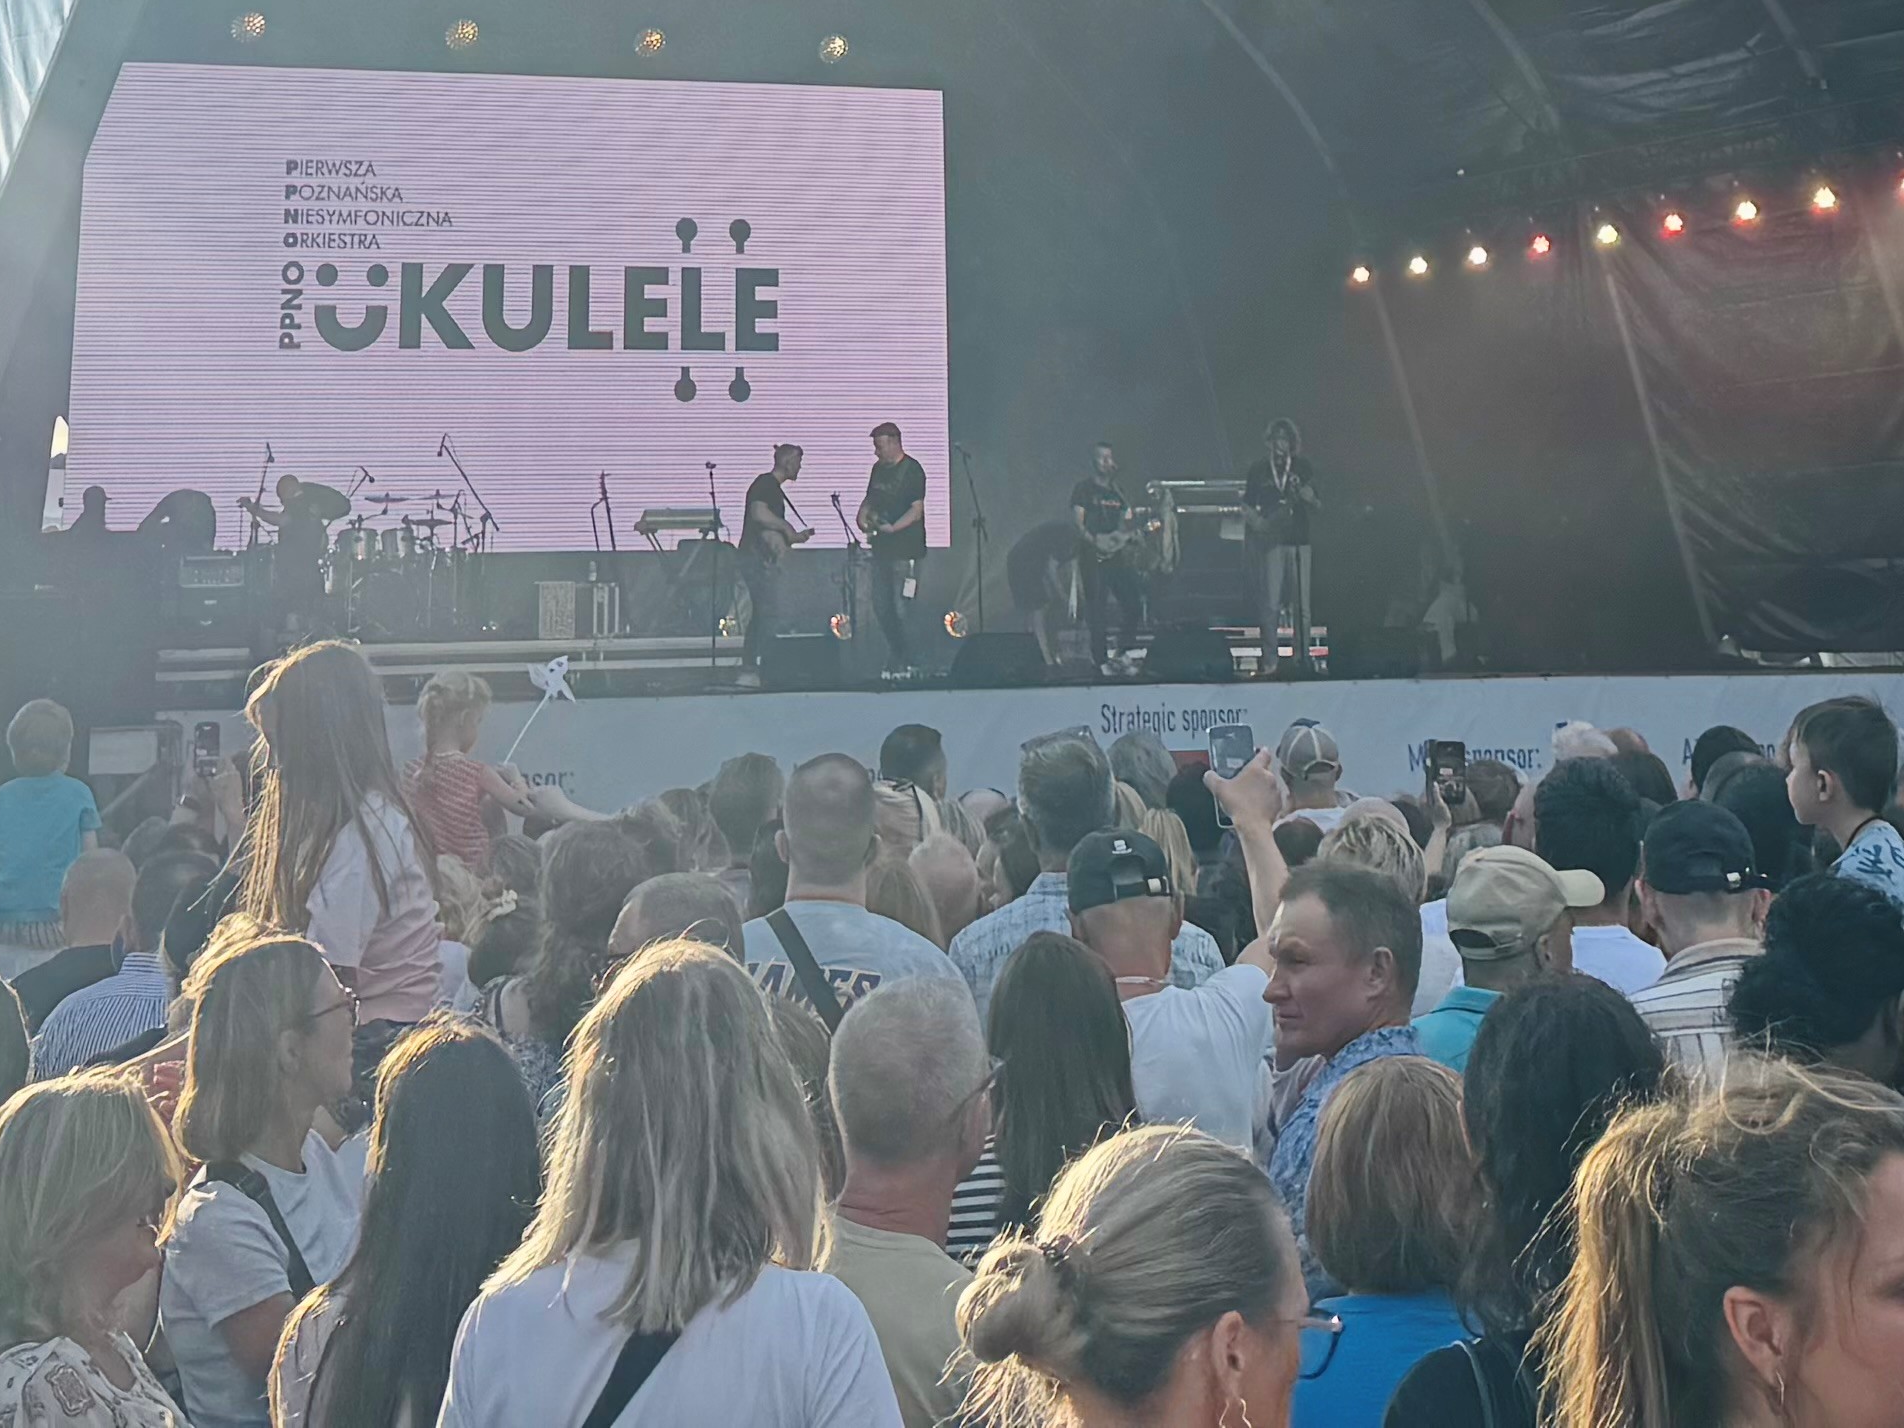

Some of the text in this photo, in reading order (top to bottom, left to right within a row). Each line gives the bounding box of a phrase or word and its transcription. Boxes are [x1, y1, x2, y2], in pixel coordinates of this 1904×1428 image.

[285, 159, 377, 177] PIERWSZA
[283, 181, 404, 203] POZNAŃSKA
[283, 207, 454, 227] NIESYMFONICZNA
[282, 232, 382, 250] ORKIESTRA
[278, 259, 305, 350] PPNO
